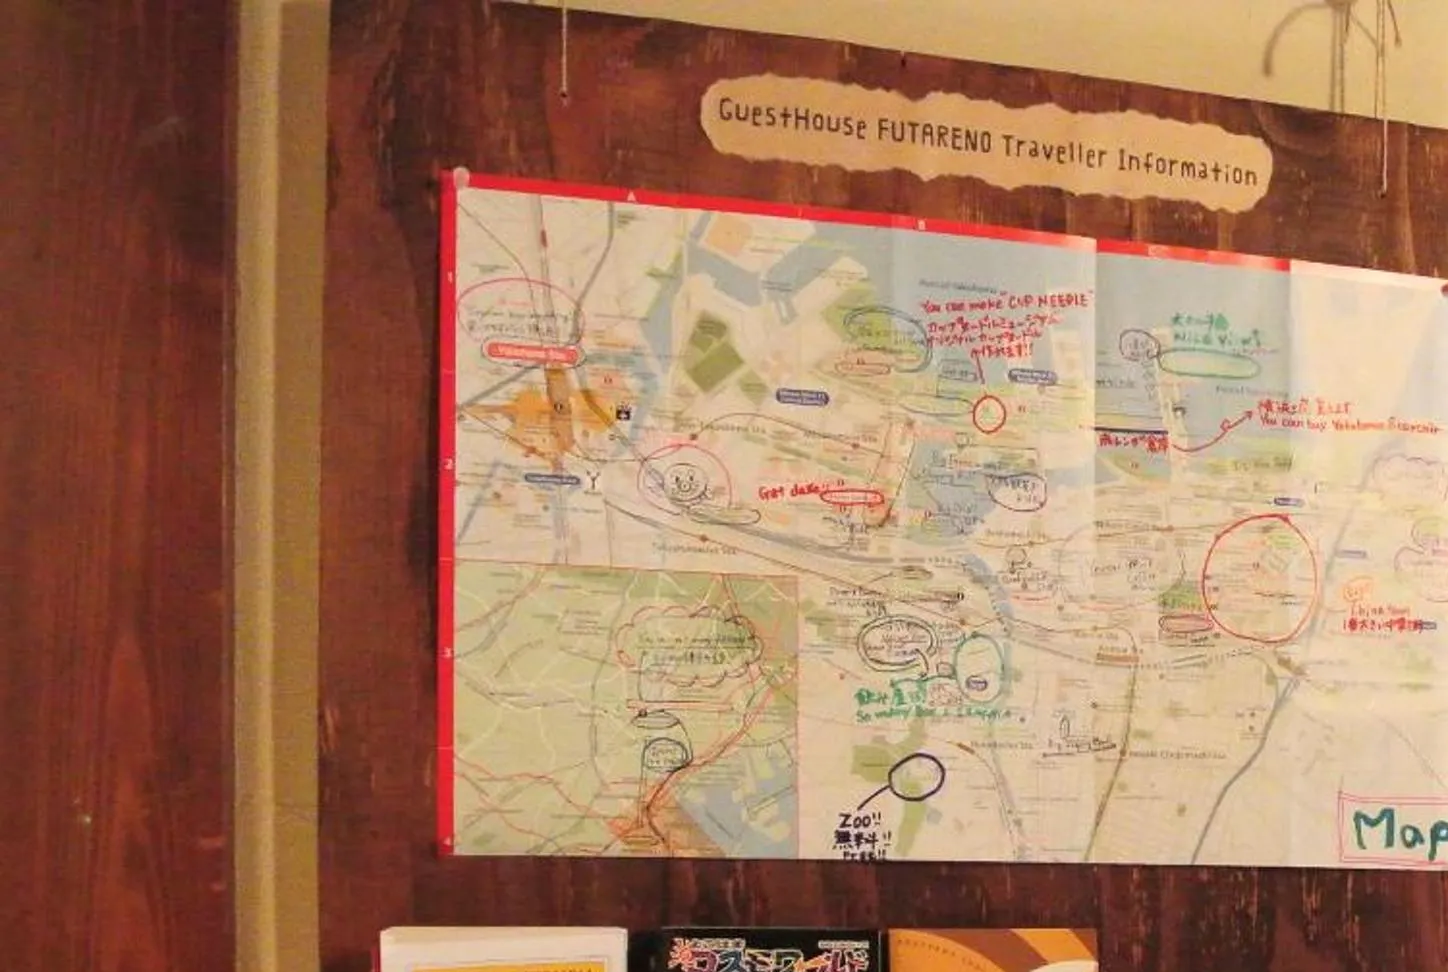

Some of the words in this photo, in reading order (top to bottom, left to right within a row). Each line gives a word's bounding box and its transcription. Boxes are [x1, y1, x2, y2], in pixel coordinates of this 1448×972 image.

[718, 98, 867, 140] GuestHouse
[877, 117, 992, 154] FUTARENO
[1003, 134, 1106, 168] Traveller
[1117, 148, 1258, 186] Information
